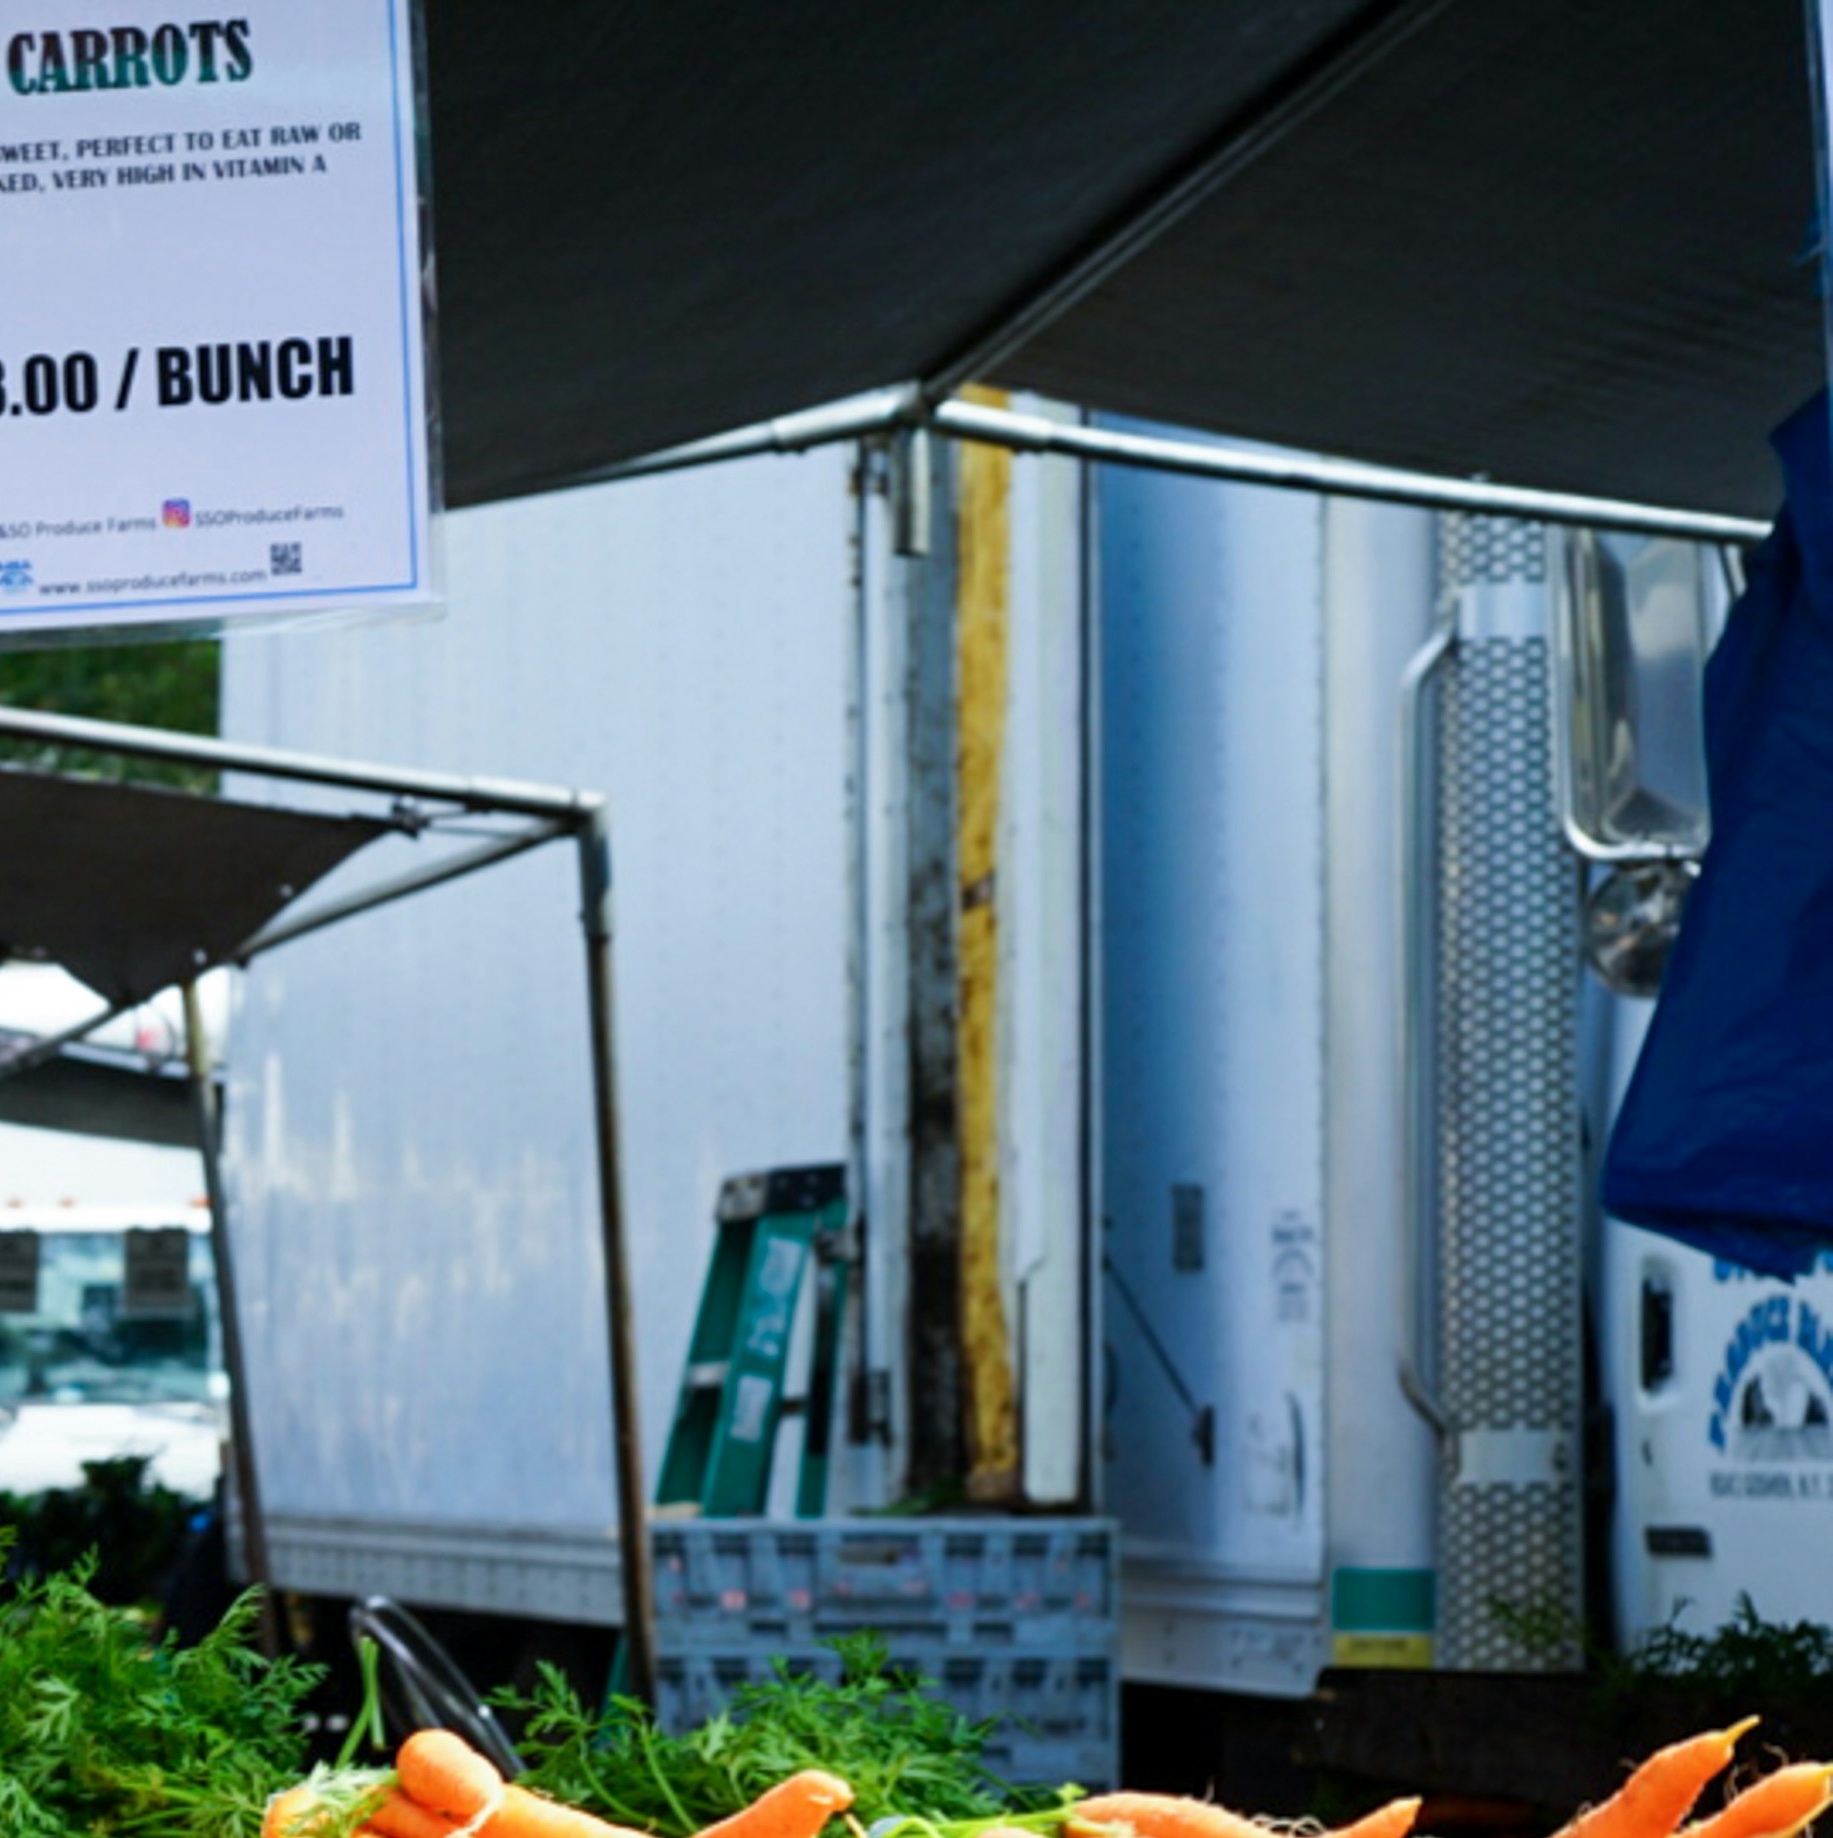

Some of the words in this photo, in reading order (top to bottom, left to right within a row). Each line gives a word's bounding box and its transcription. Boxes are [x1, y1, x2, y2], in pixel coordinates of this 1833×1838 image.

[6, 19, 252, 95] CARROTS
[77, 133, 175, 158] PERFECT
[185, 131, 214, 151] TO
[222, 128, 262, 149] EAT
[271, 125, 321, 146] RAW
[328, 122, 361, 142] OR
[52, 167, 108, 190] VERY
[117, 163, 174, 186] HIGH
[182, 161, 206, 182] IN
[212, 155, 305, 180] VITAMIN
[312, 153, 327, 173] A
[114, 348, 139, 412] /
[157, 335, 354, 407] BUNCH
[36, 518, 102, 537] Produce
[107, 514, 158, 533] Farms
